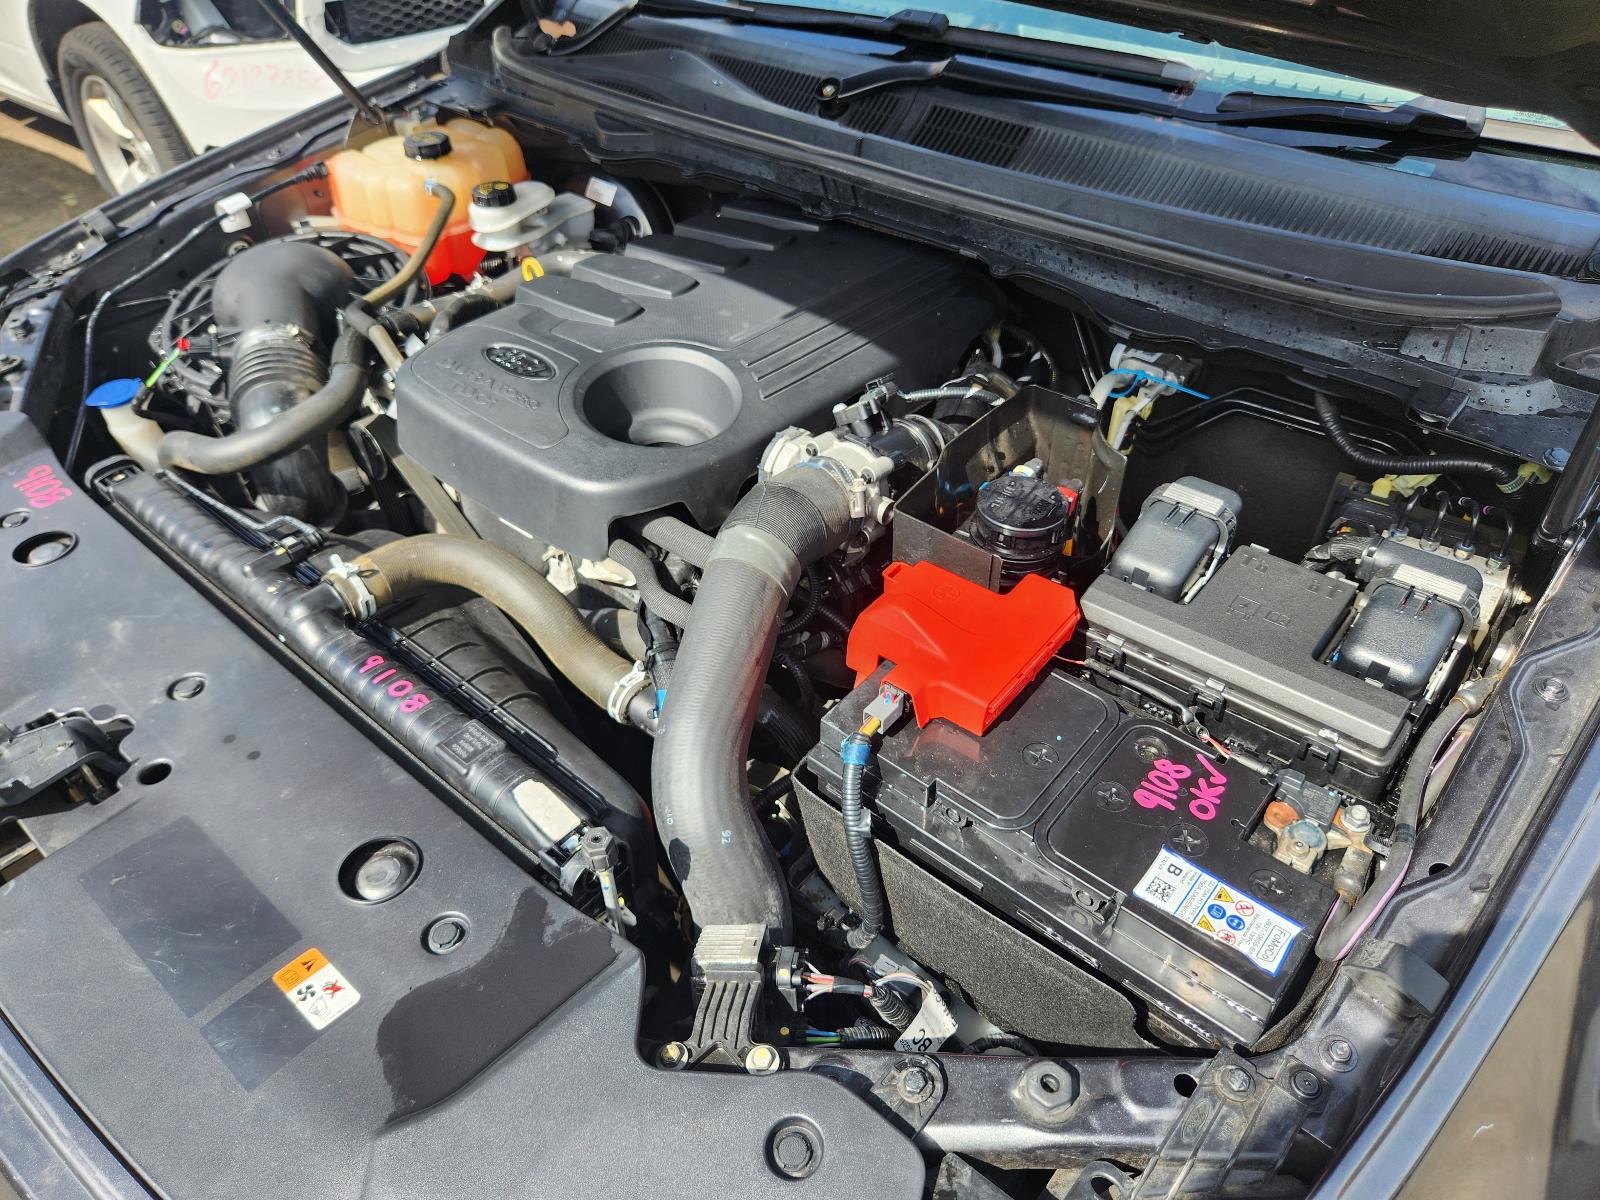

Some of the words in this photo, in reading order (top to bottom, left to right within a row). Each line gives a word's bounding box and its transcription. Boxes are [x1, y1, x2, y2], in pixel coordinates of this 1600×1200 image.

[359, 655, 430, 713] 9108
[1133, 759, 1192, 811] 9108
[1167, 863, 1183, 877] B
[1261, 929, 1286, 960] FoMoCo
[912, 1028, 932, 1051] BC
